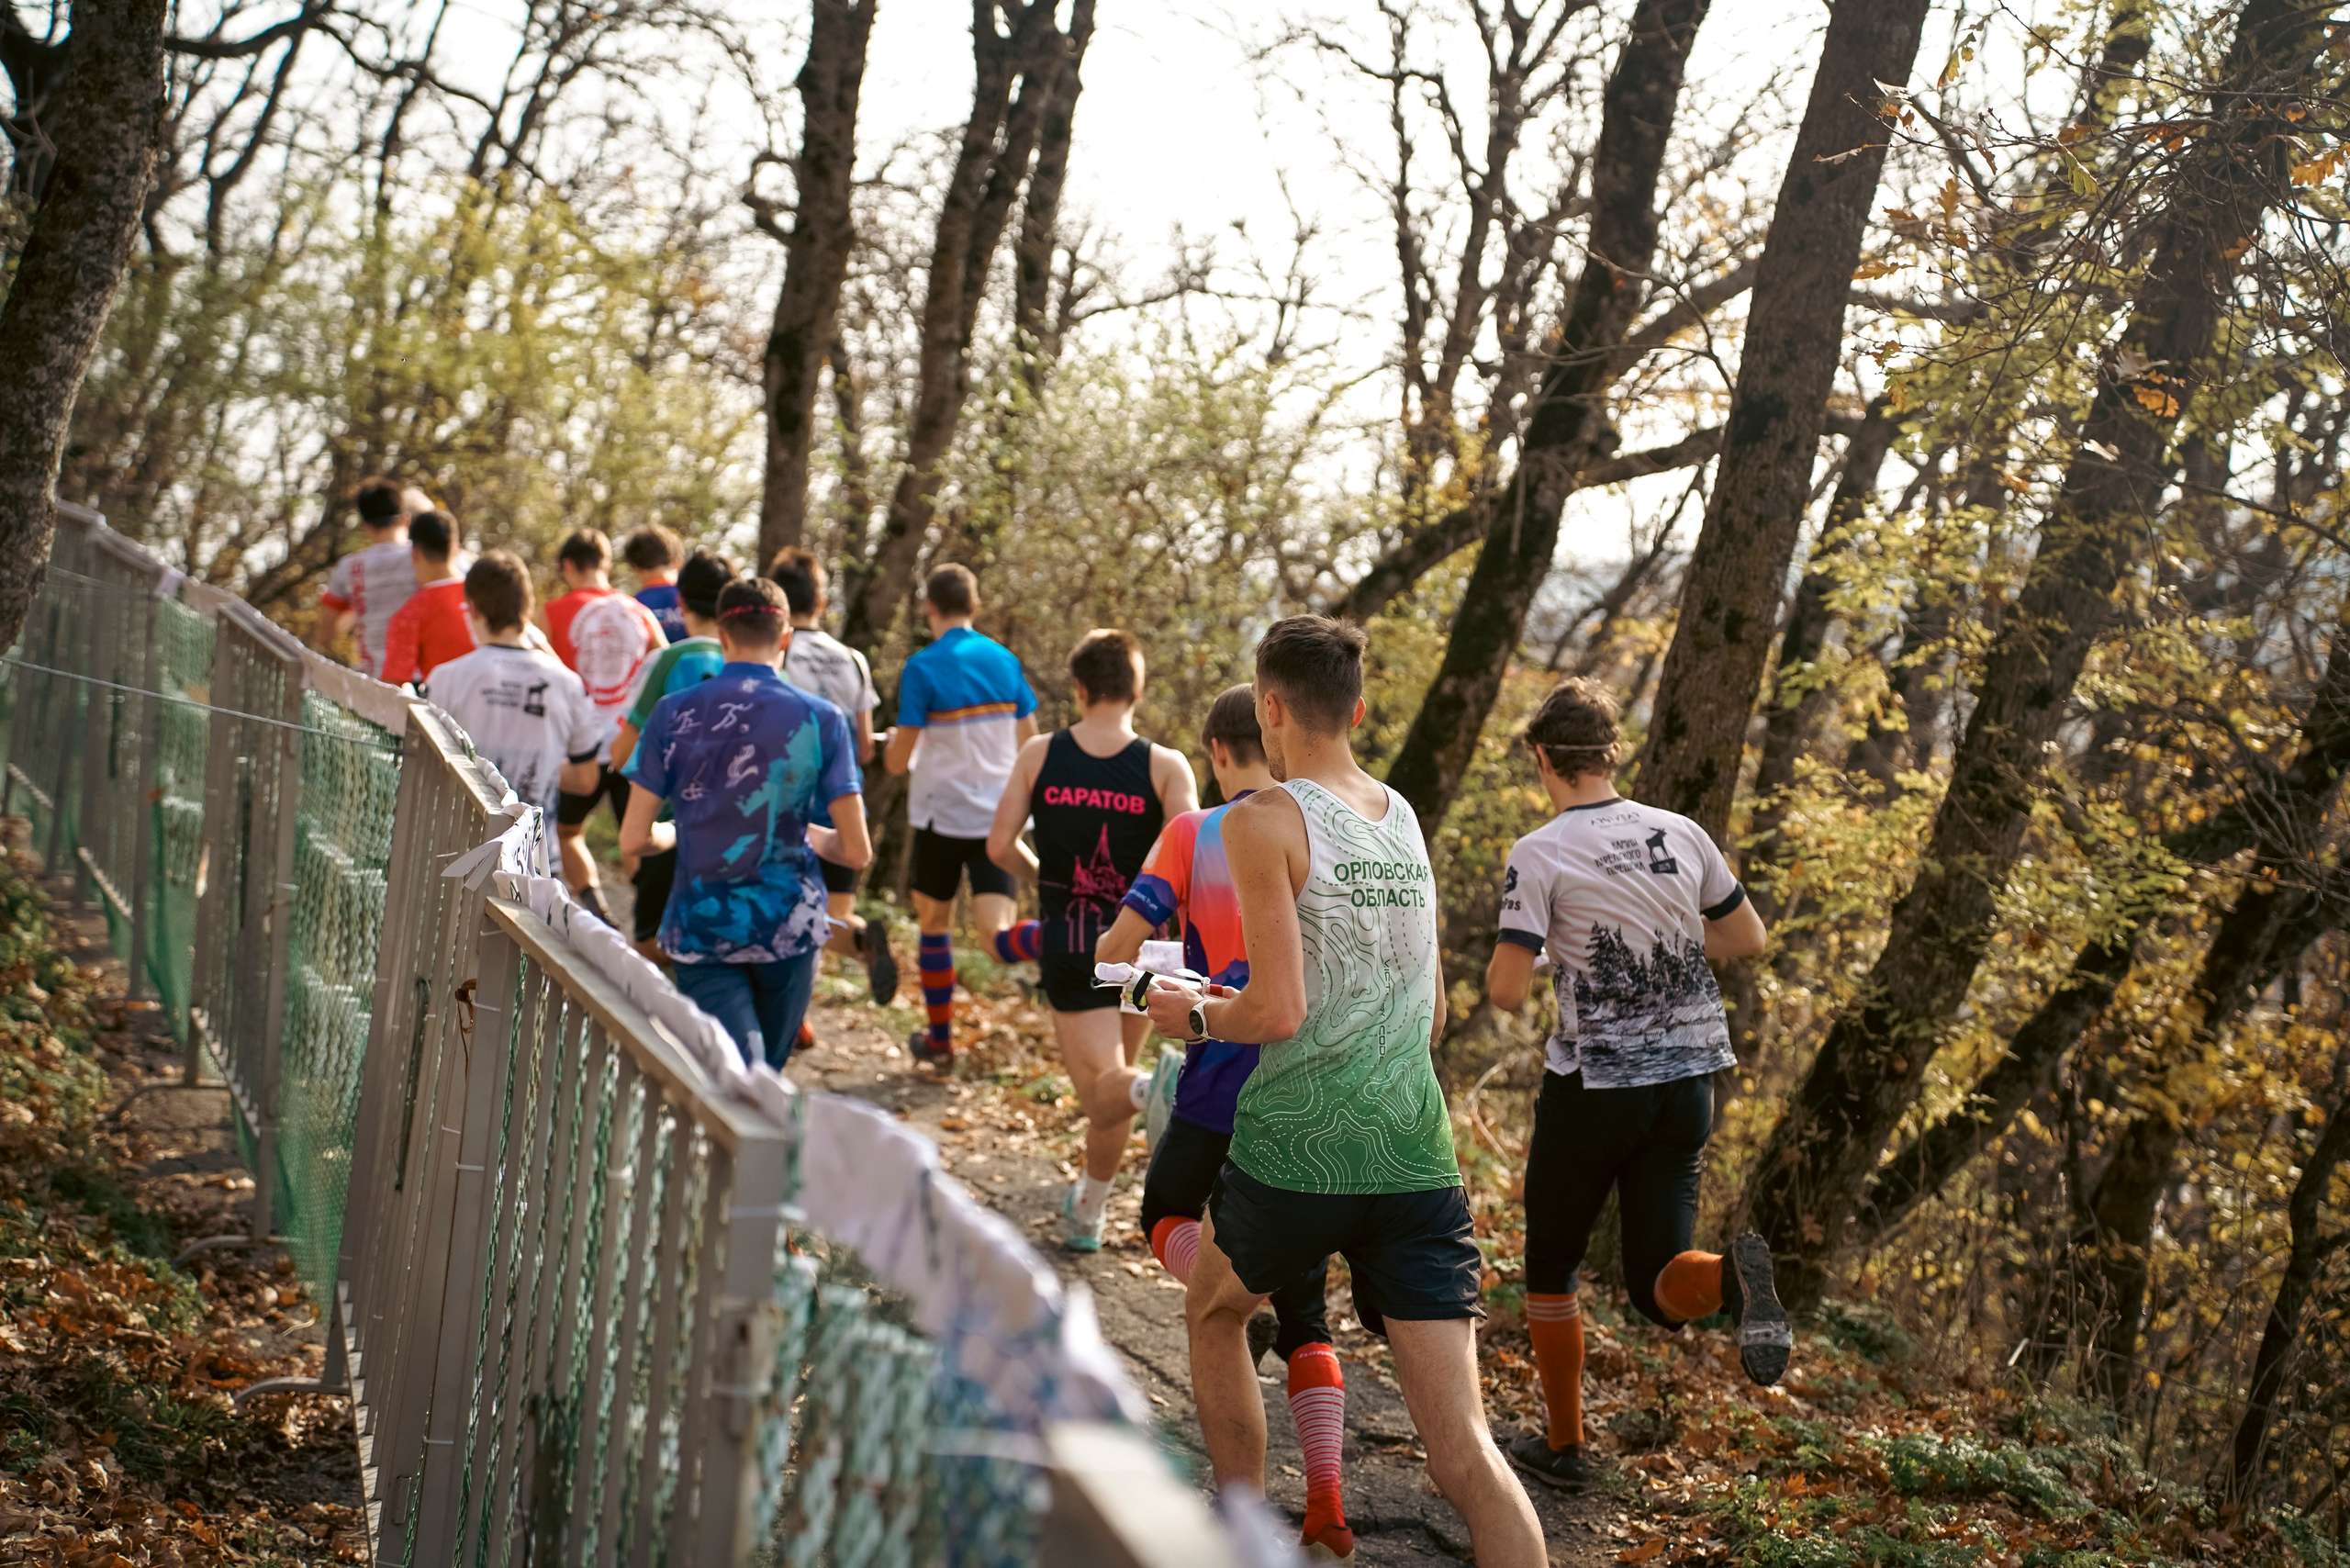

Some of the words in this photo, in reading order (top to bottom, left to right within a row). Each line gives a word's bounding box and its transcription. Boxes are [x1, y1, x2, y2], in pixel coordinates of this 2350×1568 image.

[1044, 786, 1146, 814] САРАТОВ
[1334, 861, 1428, 882] ОРЛОВСКАЯ
[1350, 889, 1426, 908] ОБЛАСТЬ
[1379, 958, 1391, 1017] VICTRY
